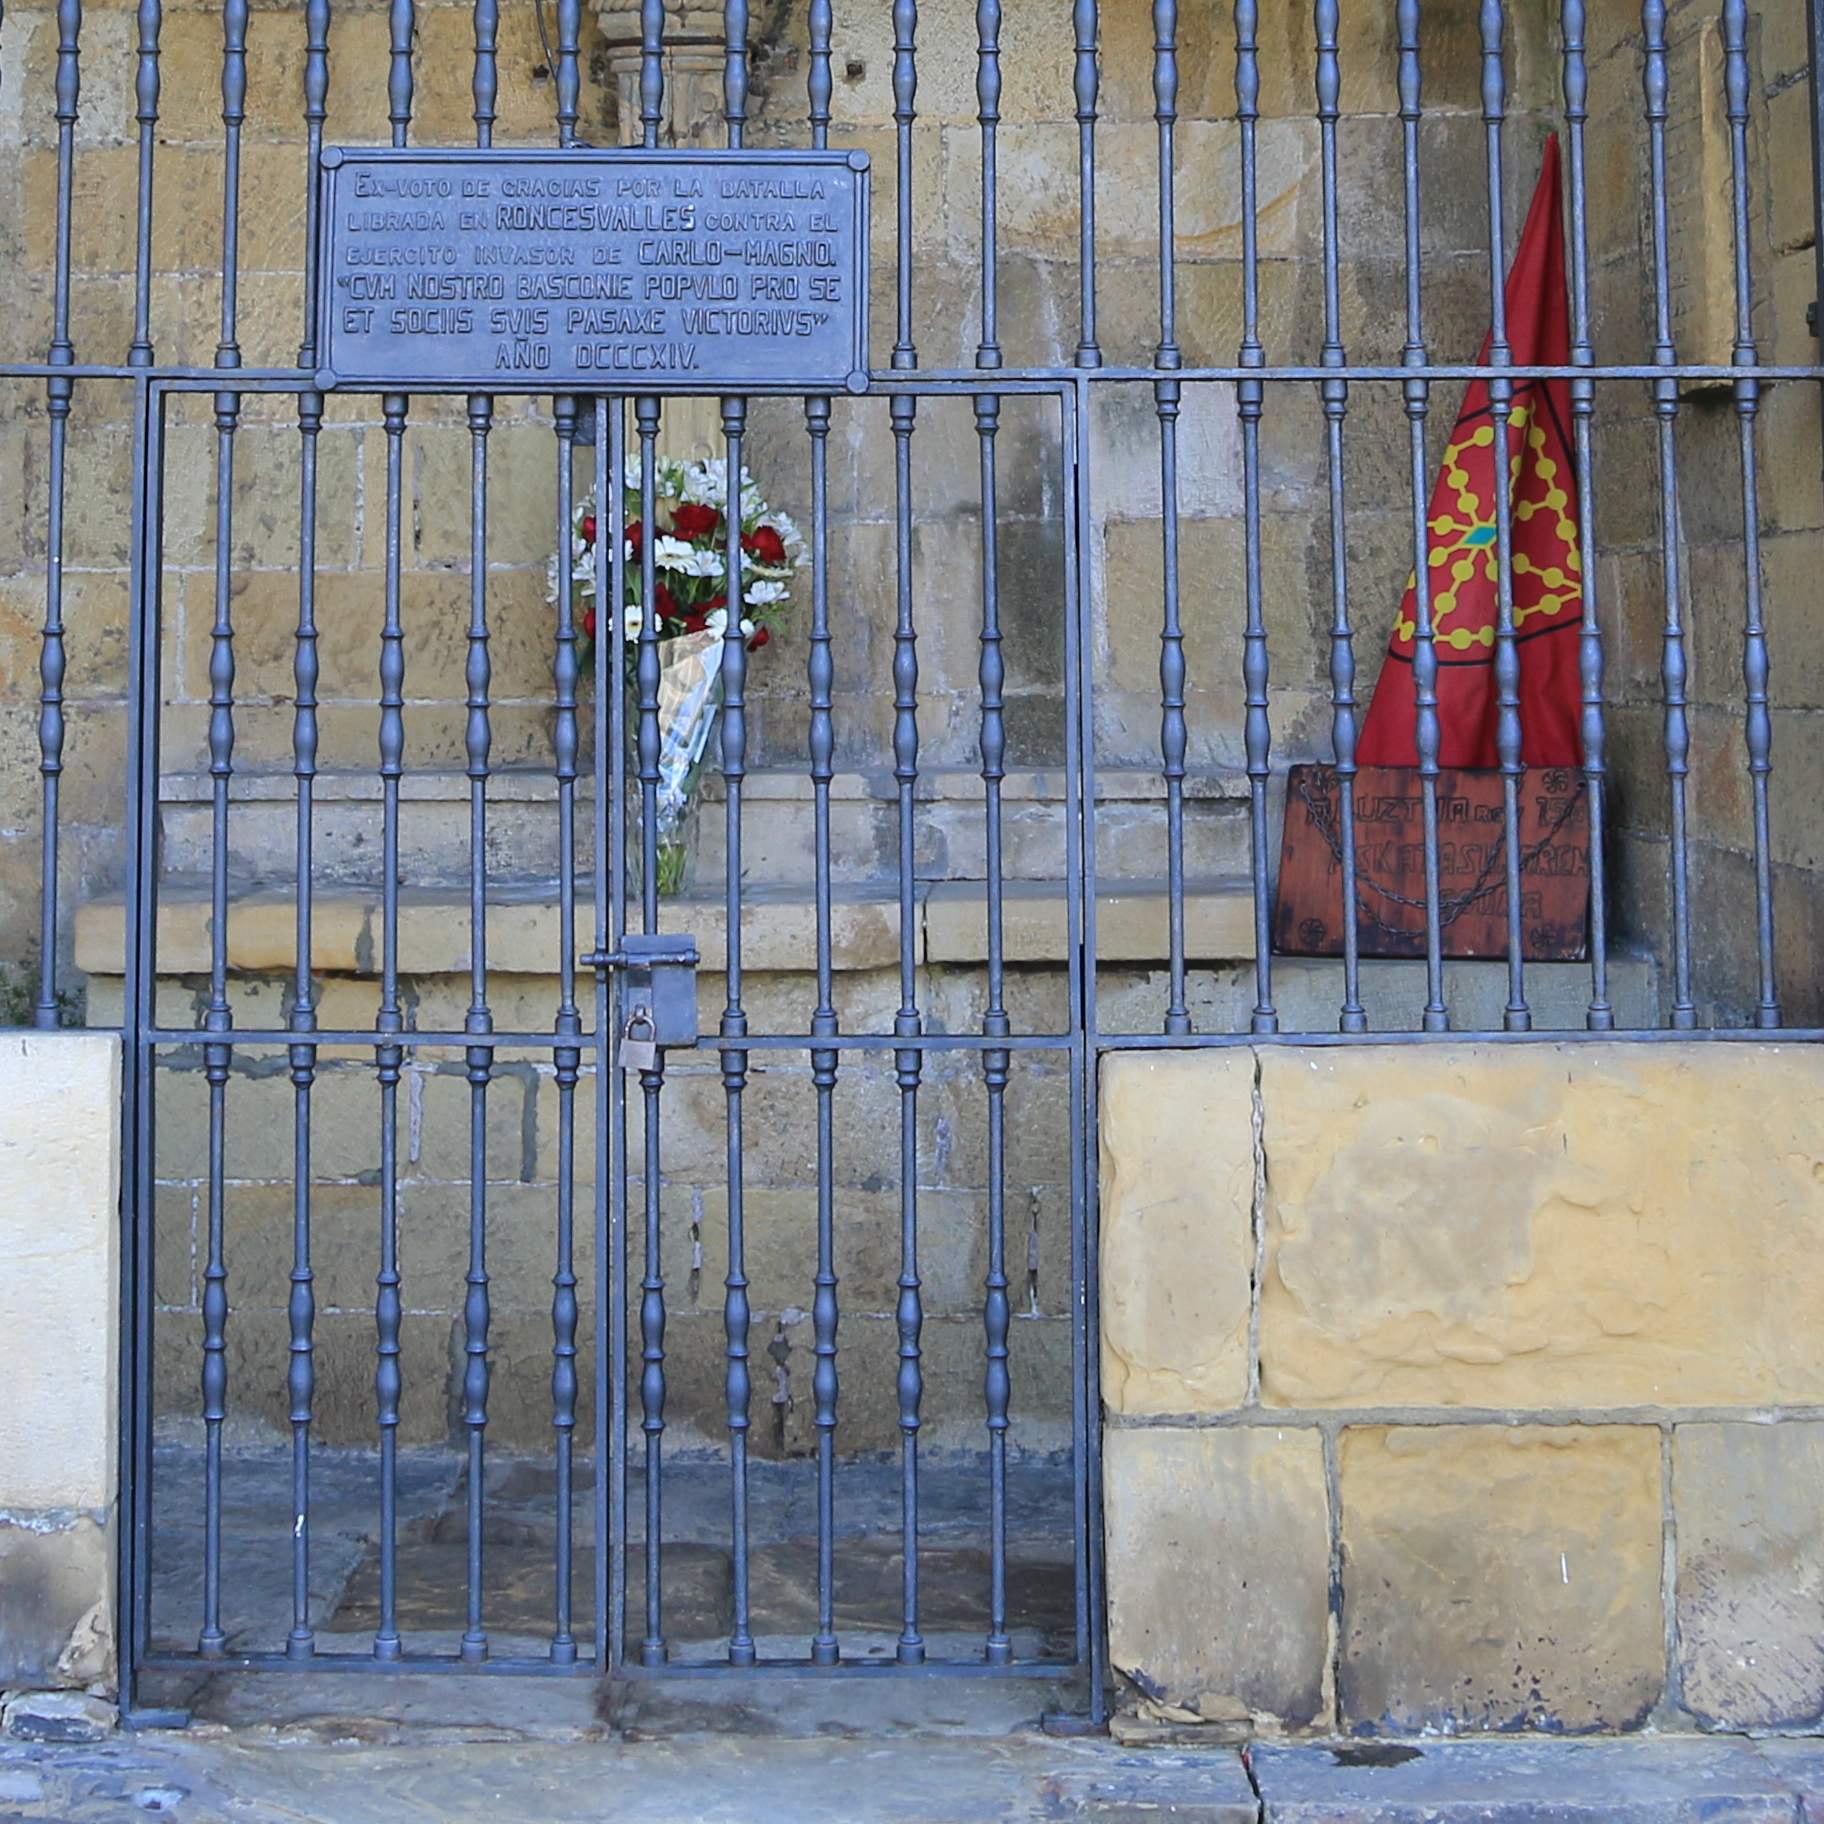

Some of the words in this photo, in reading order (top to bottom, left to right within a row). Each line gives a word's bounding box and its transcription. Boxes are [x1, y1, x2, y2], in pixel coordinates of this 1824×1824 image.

[462, 179, 490, 197] DE
[501, 178, 600, 197] GRACIAS
[617, 178, 661, 197] POR
[674, 178, 703, 197] LA
[721, 179, 825, 198] BATALLA
[347, 212, 445, 231] LIBRADA
[460, 212, 488, 231] EN
[496, 204, 696, 231] RONCESVALLES
[706, 213, 796, 232] CONTRA
[809, 214, 838, 233] EL
[346, 246, 457, 265] EJERCITO
[475, 246, 575, 266] INVASOR
[593, 247, 622, 265] DE
[638, 239, 837, 266] CARLO-MAGNO.
[407, 274, 505, 300] NOSTRO
[516, 274, 633, 300] BASCONIE
[645, 274, 738, 300] POPVLO
[751, 274, 800, 300] PRO
[809, 276, 841, 301] SE
[343, 307, 375, 334] ET
[391, 307, 473, 334] SOCIIS
[491, 307, 549, 334] SVIS
[567, 307, 665, 334] PASAXE
[495, 336, 551, 369] AÑO
[576, 342, 699, 369] DCCCXIV.
